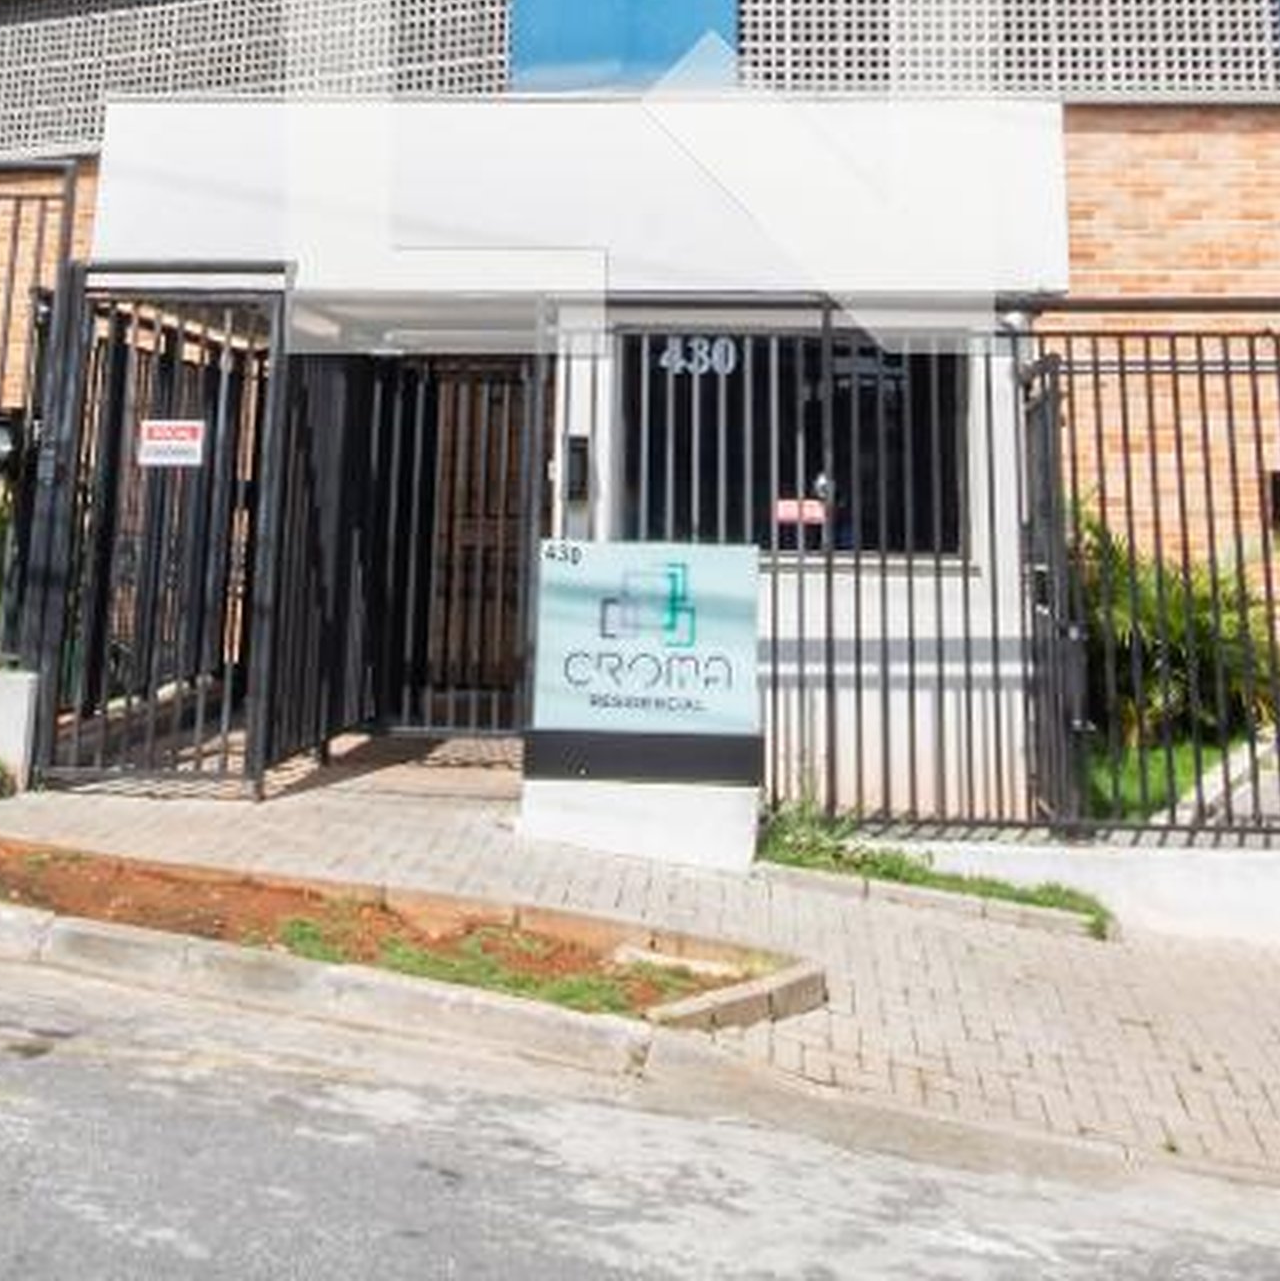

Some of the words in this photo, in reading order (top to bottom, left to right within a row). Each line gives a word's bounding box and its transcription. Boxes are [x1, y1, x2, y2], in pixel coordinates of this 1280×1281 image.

[659, 335, 737, 376] 430
[545, 543, 583, 566] 430
[563, 652, 733, 689] CROMA
